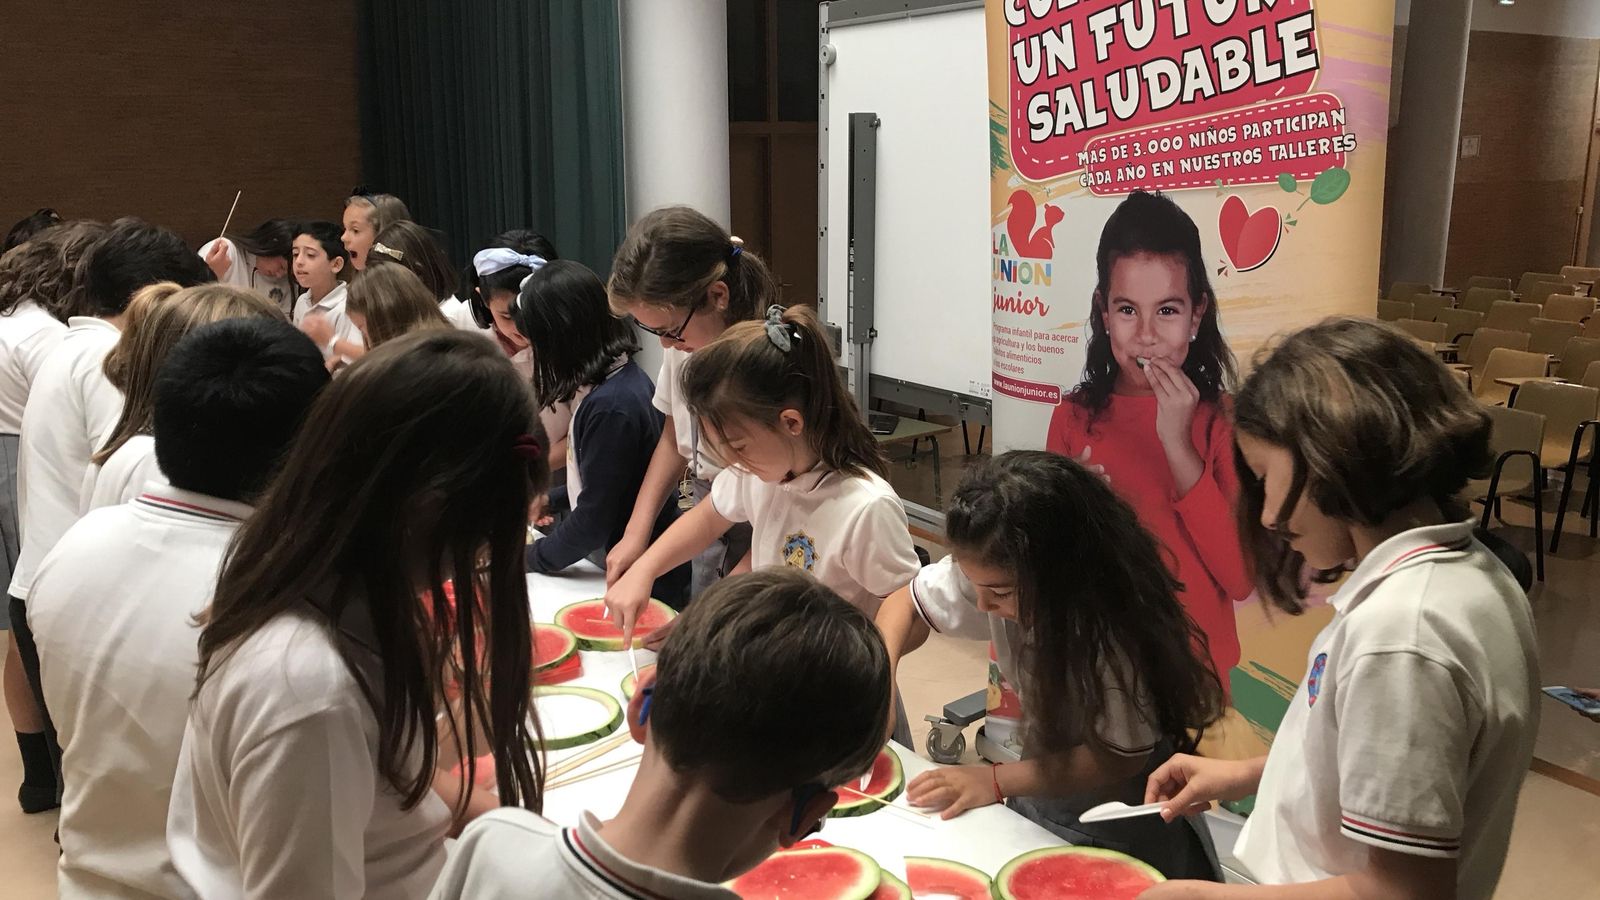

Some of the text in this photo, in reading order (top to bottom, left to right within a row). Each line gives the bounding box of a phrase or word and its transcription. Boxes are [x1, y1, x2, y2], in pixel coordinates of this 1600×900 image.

[1013, 20, 1077, 86] UN
[1027, 10, 1319, 143] SALUDABLE
[1111, 144, 1128, 161] DE
[1133, 135, 1183, 157] 3.000
[1189, 125, 1237, 149] NIÑOS
[1242, 107, 1346, 140] PARTICIPAN
[1080, 133, 1357, 187] CADA AÑO EN NUESTROS TALLERES
[993, 232, 1009, 256] LA
[992, 257, 1052, 287] UNION
[993, 286, 1050, 317] junior
[1025, 341, 1036, 351] los
[1037, 343, 1065, 355] buenos
[1033, 331, 1050, 341] para
[1051, 333, 1079, 343] acercar
[1006, 350, 1042, 365] alimenticios
